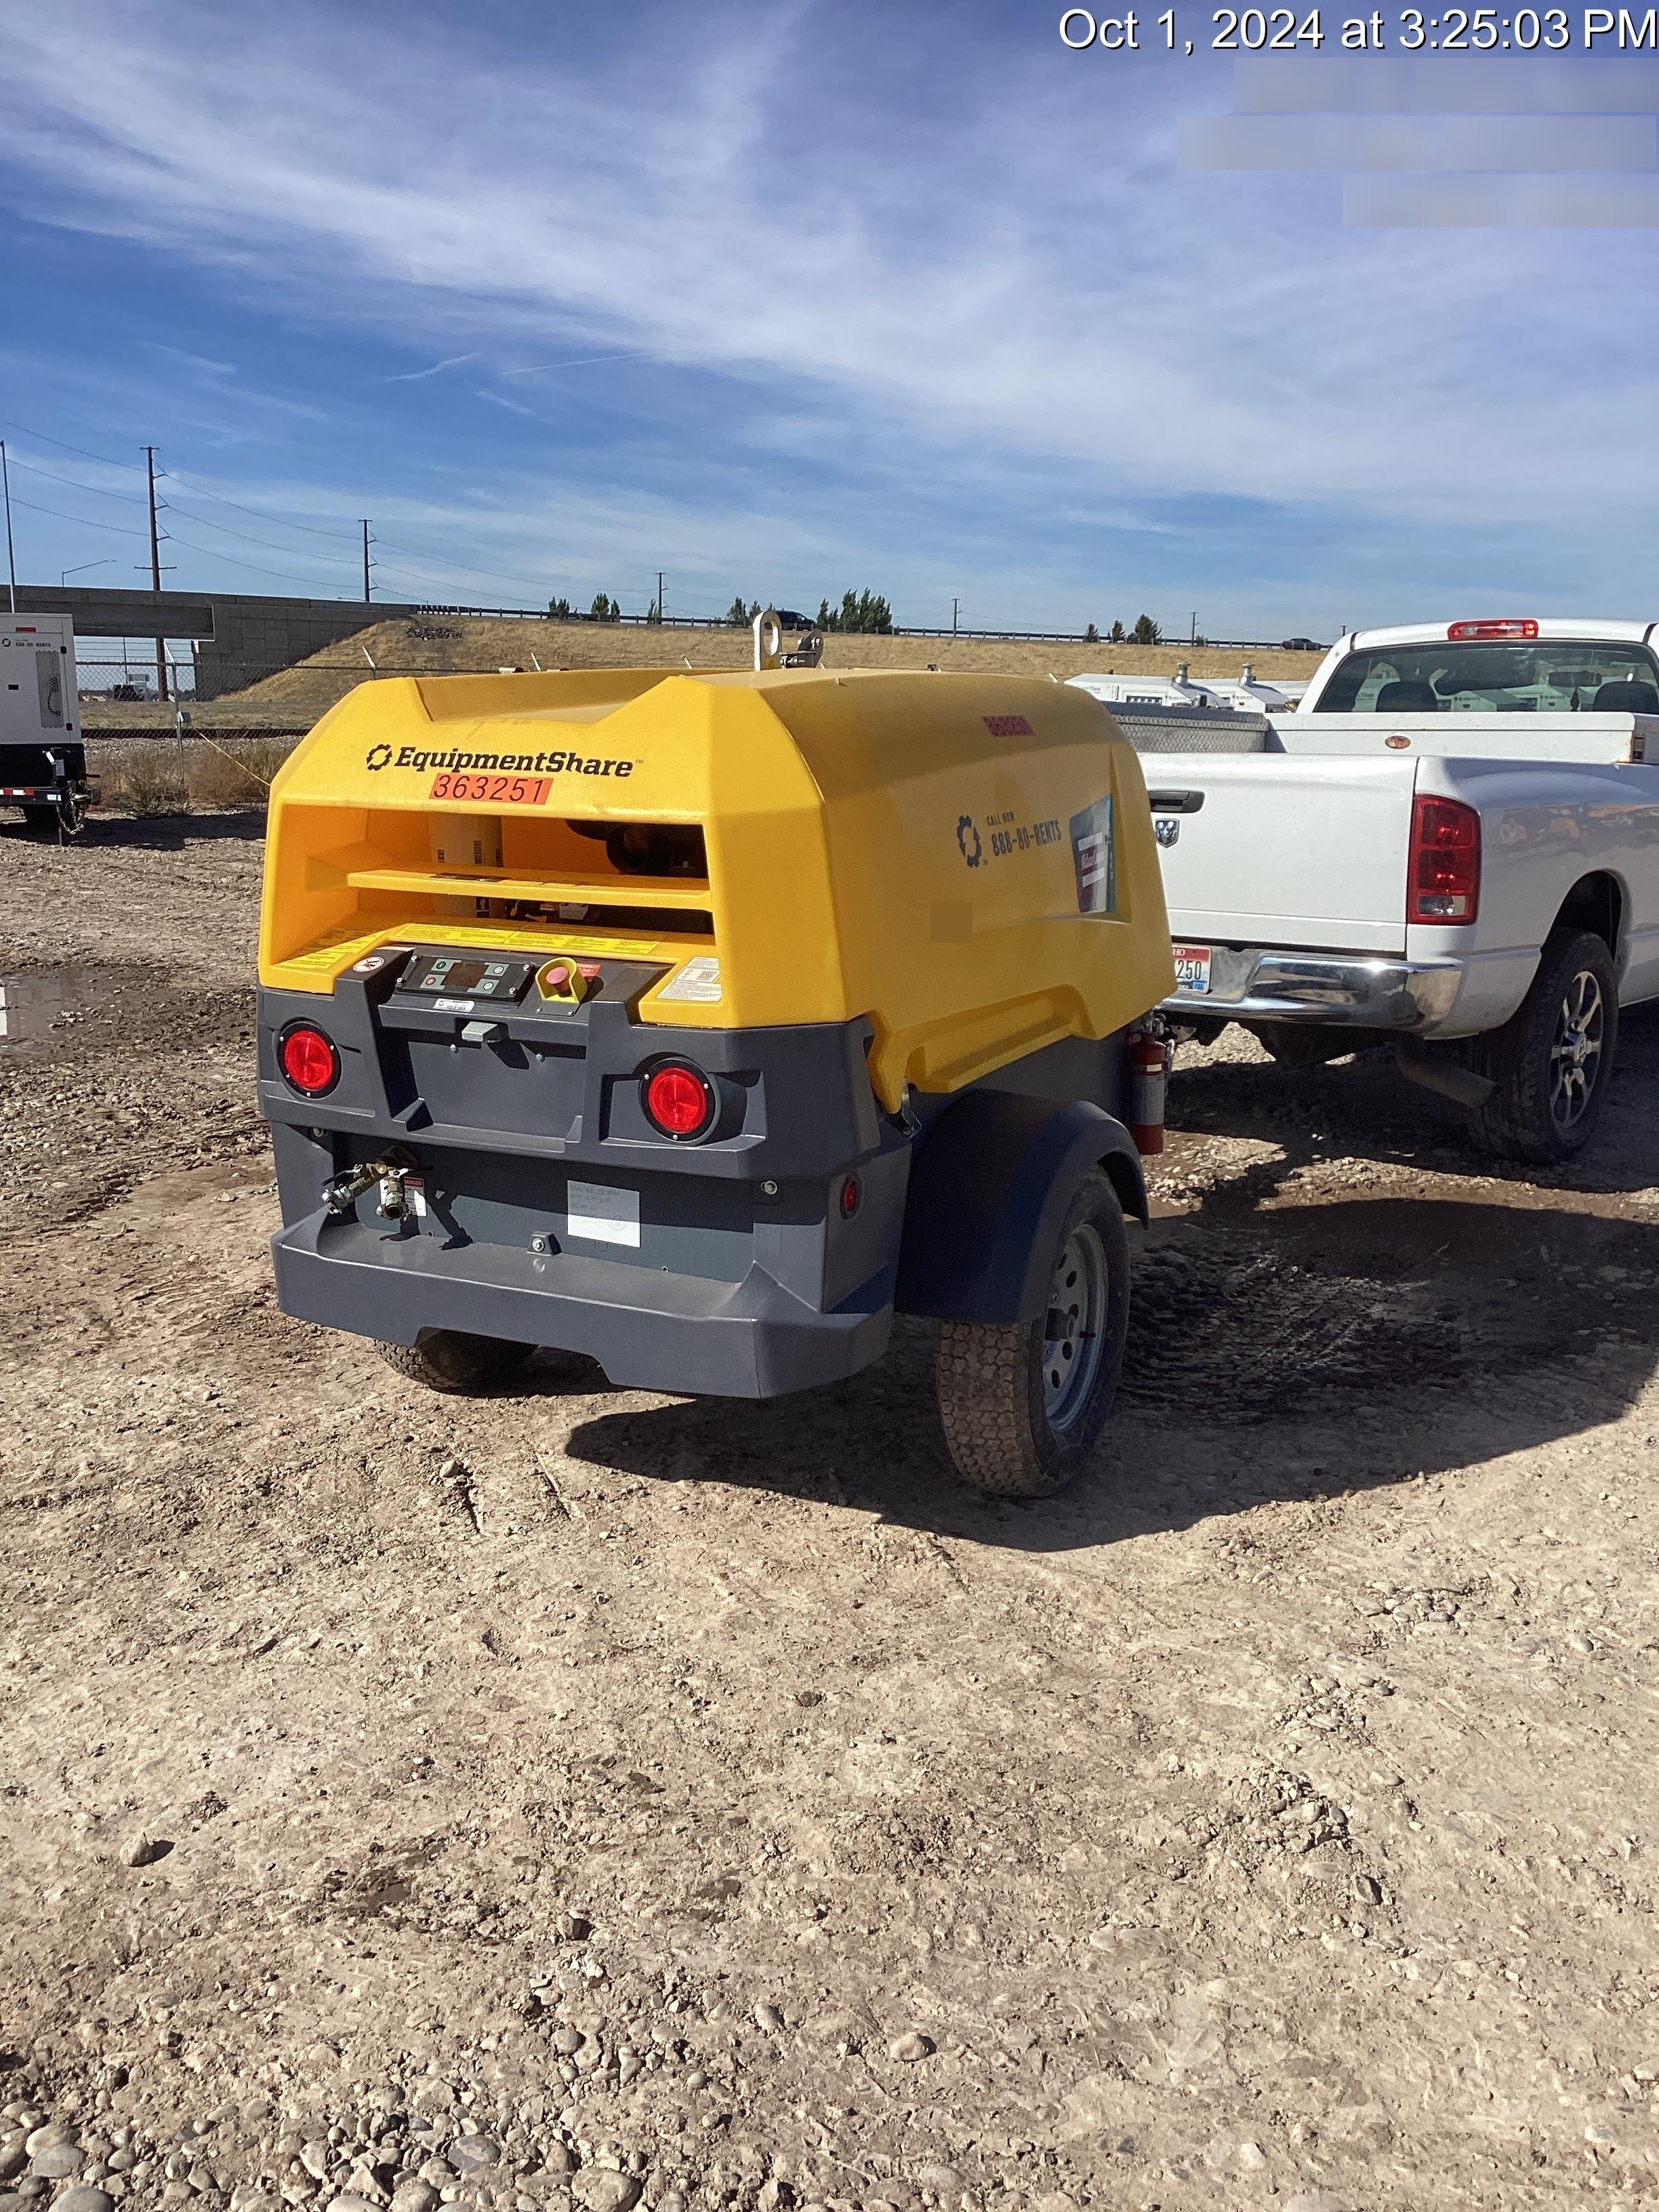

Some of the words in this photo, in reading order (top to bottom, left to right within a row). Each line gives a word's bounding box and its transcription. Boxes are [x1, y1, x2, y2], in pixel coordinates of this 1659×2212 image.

[434, 774, 544, 802] 363251
[987, 815, 1002, 826] CALL
[1002, 811, 1015, 823] NOW
[991, 819, 1062, 857] 888-80-RENTS
